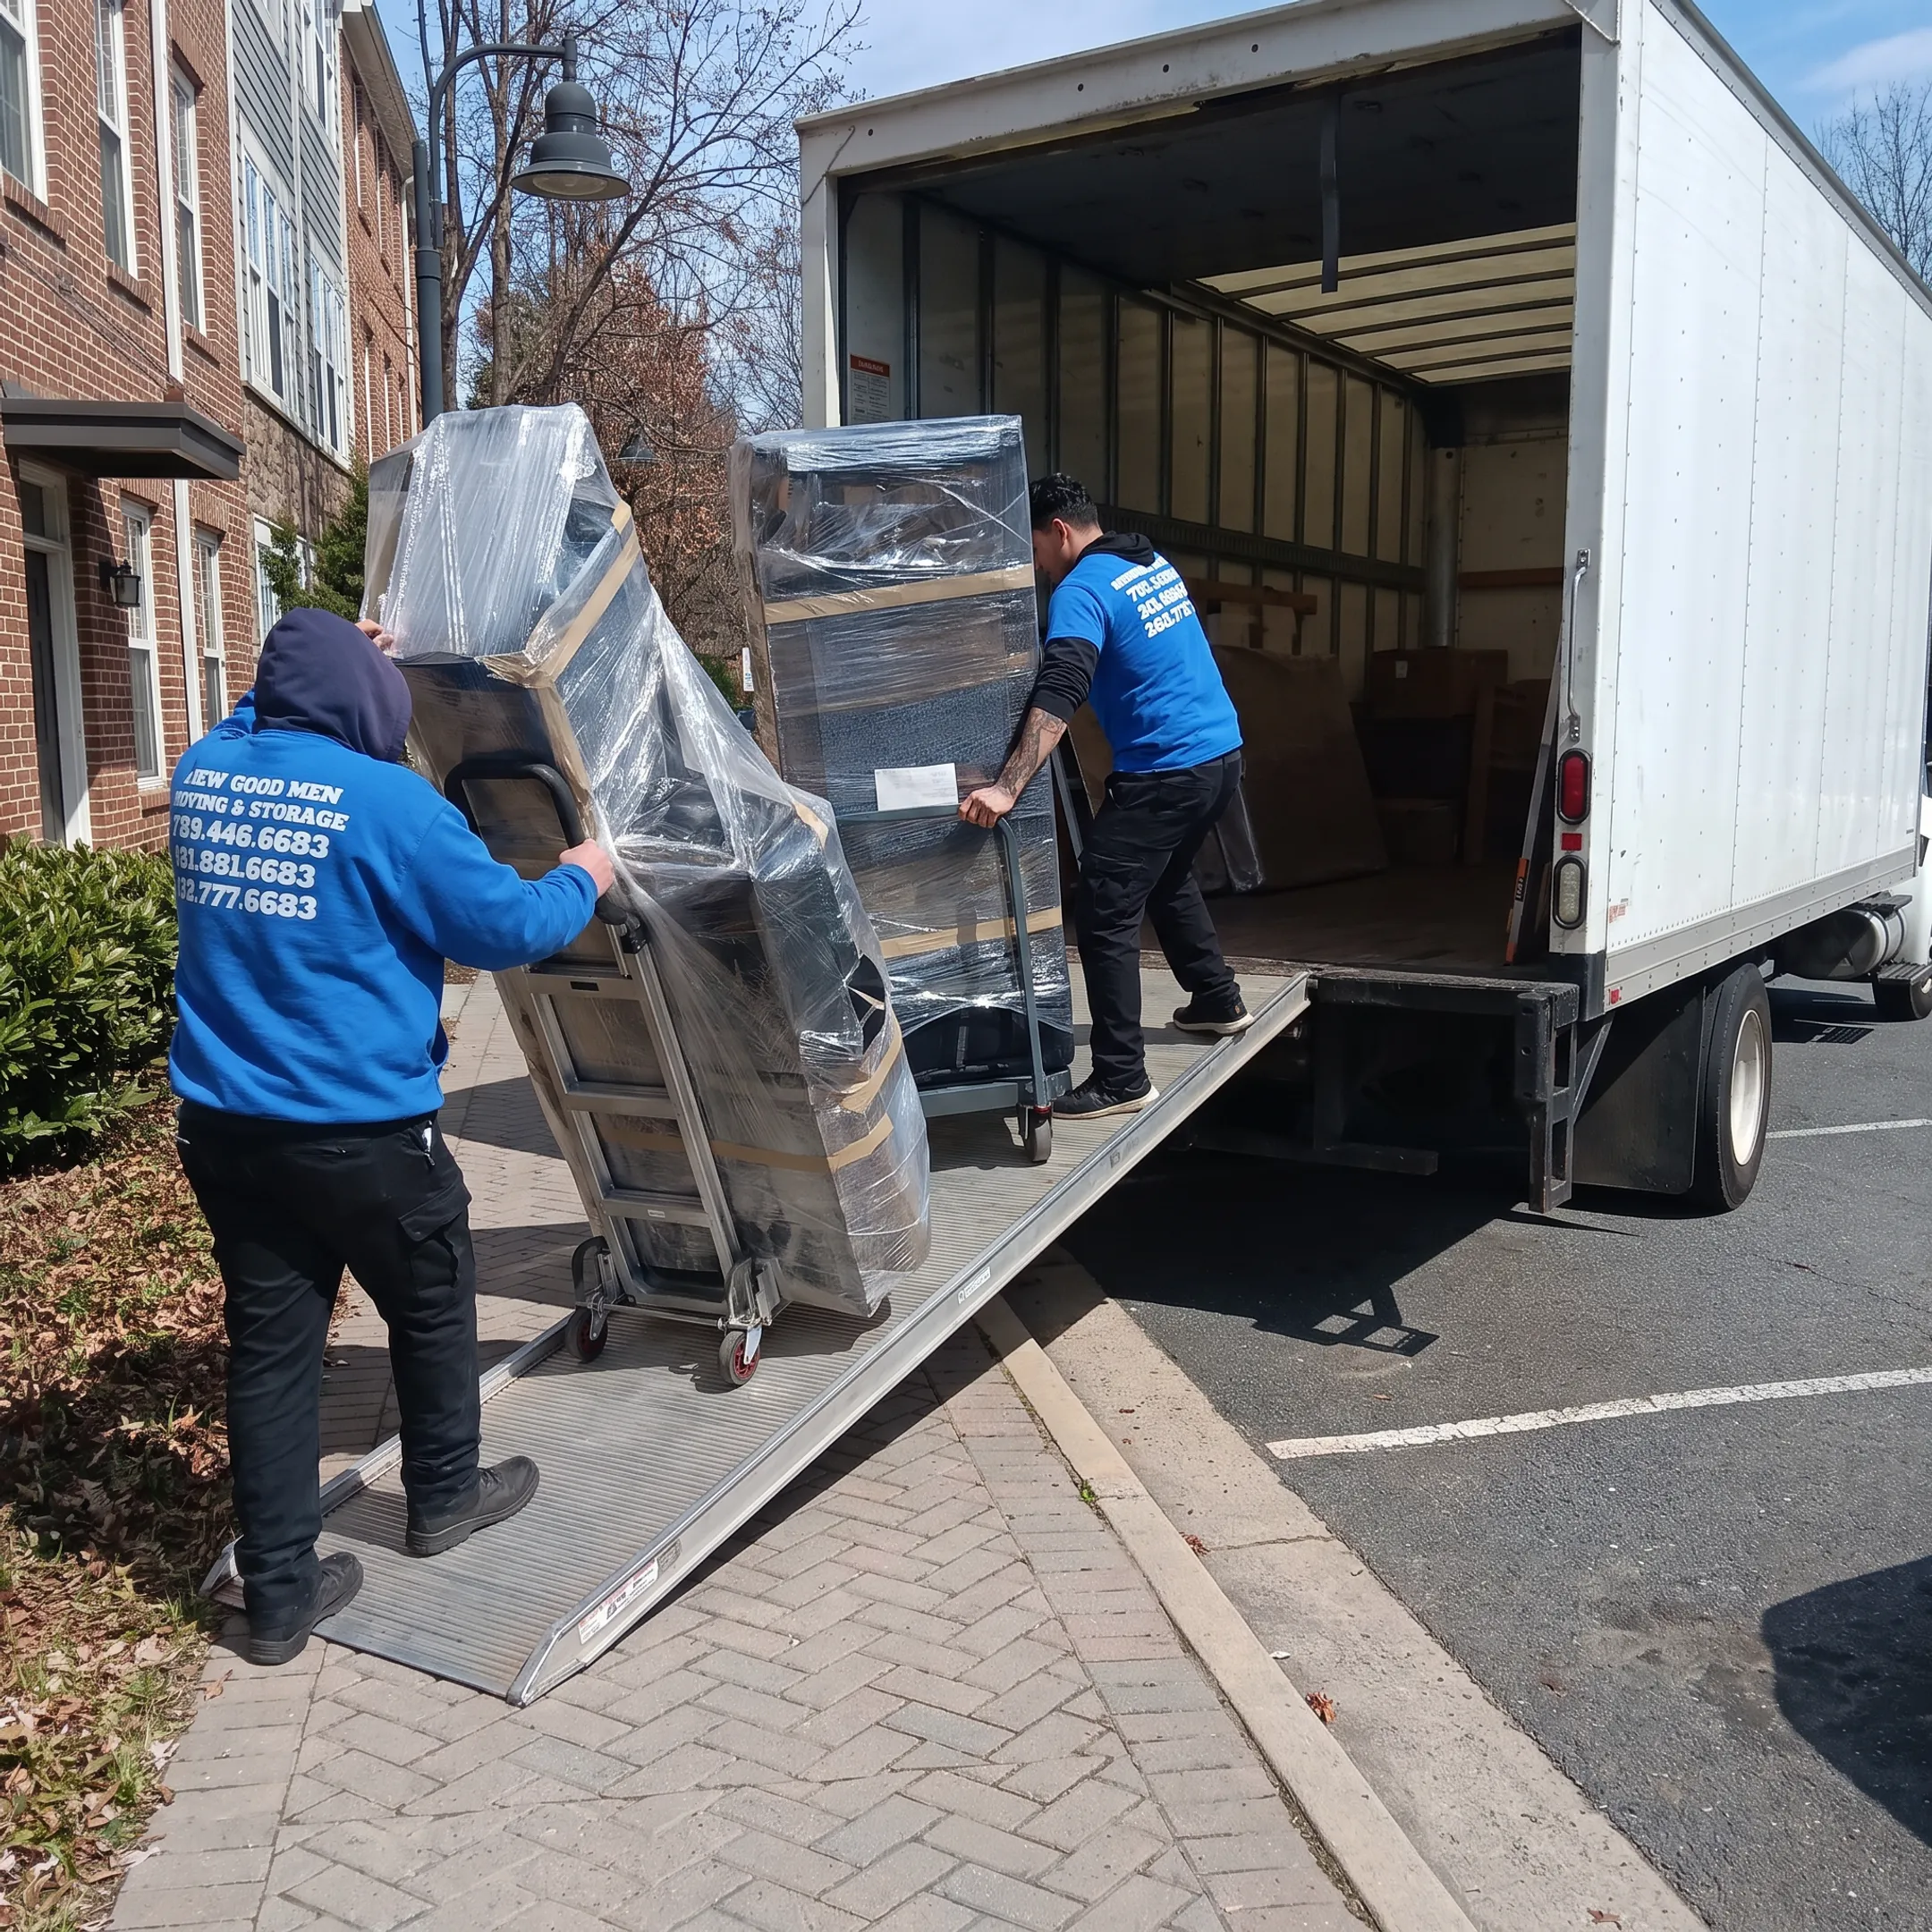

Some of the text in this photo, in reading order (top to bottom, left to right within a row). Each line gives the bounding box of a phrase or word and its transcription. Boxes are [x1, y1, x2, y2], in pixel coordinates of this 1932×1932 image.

[230, 775, 284, 796] GOOD
[286, 780, 344, 805] MEN
[230, 799, 245, 817] &
[248, 801, 350, 832] STORAGE
